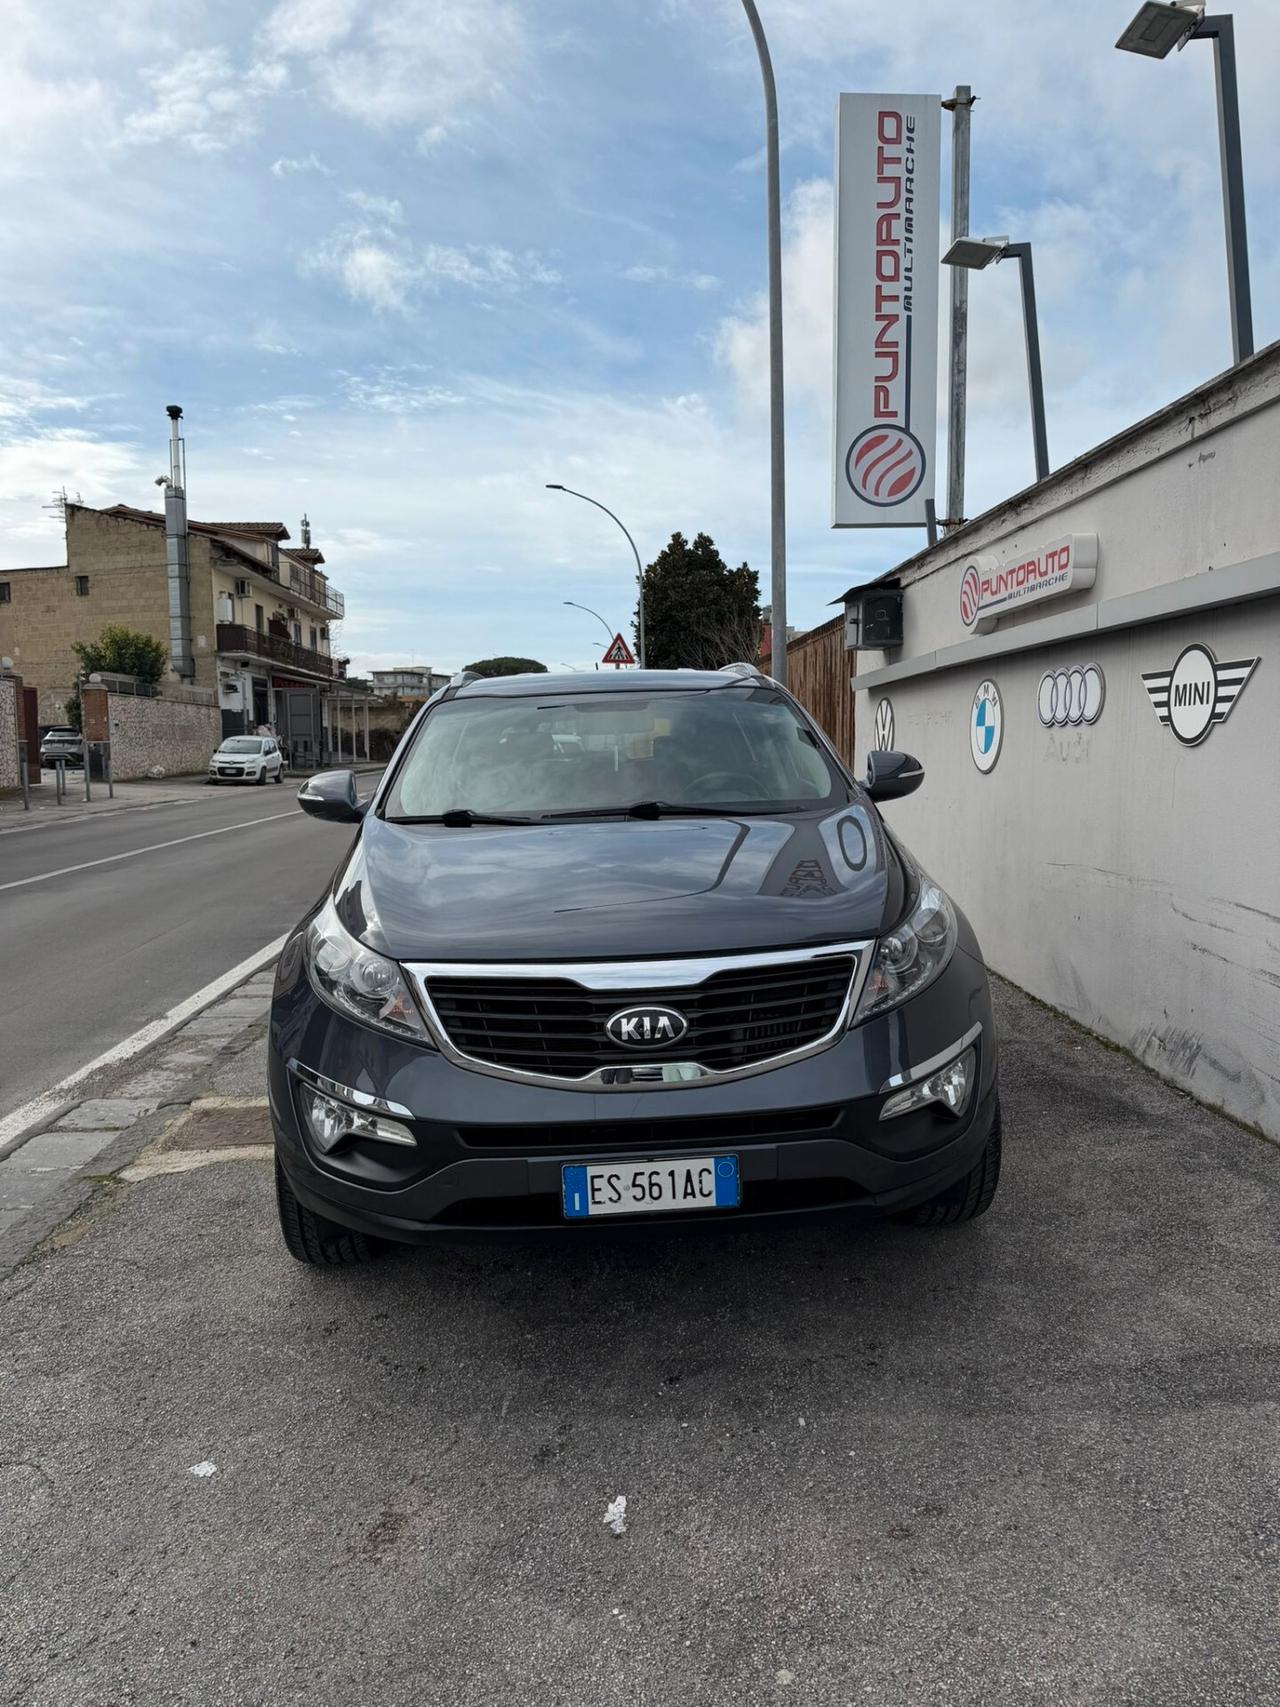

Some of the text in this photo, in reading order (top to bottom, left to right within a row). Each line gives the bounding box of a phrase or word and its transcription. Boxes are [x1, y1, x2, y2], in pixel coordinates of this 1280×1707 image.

[903, 114, 917, 313] MULTIMARCHE
[873, 110, 903, 418] PUNTOAUTO
[981, 545, 1070, 600] PUNTOAUTO
[1007, 572, 1069, 600] MULTIMARCHE
[1173, 680, 1211, 708] MINI
[620, 1016, 675, 1040] KIA
